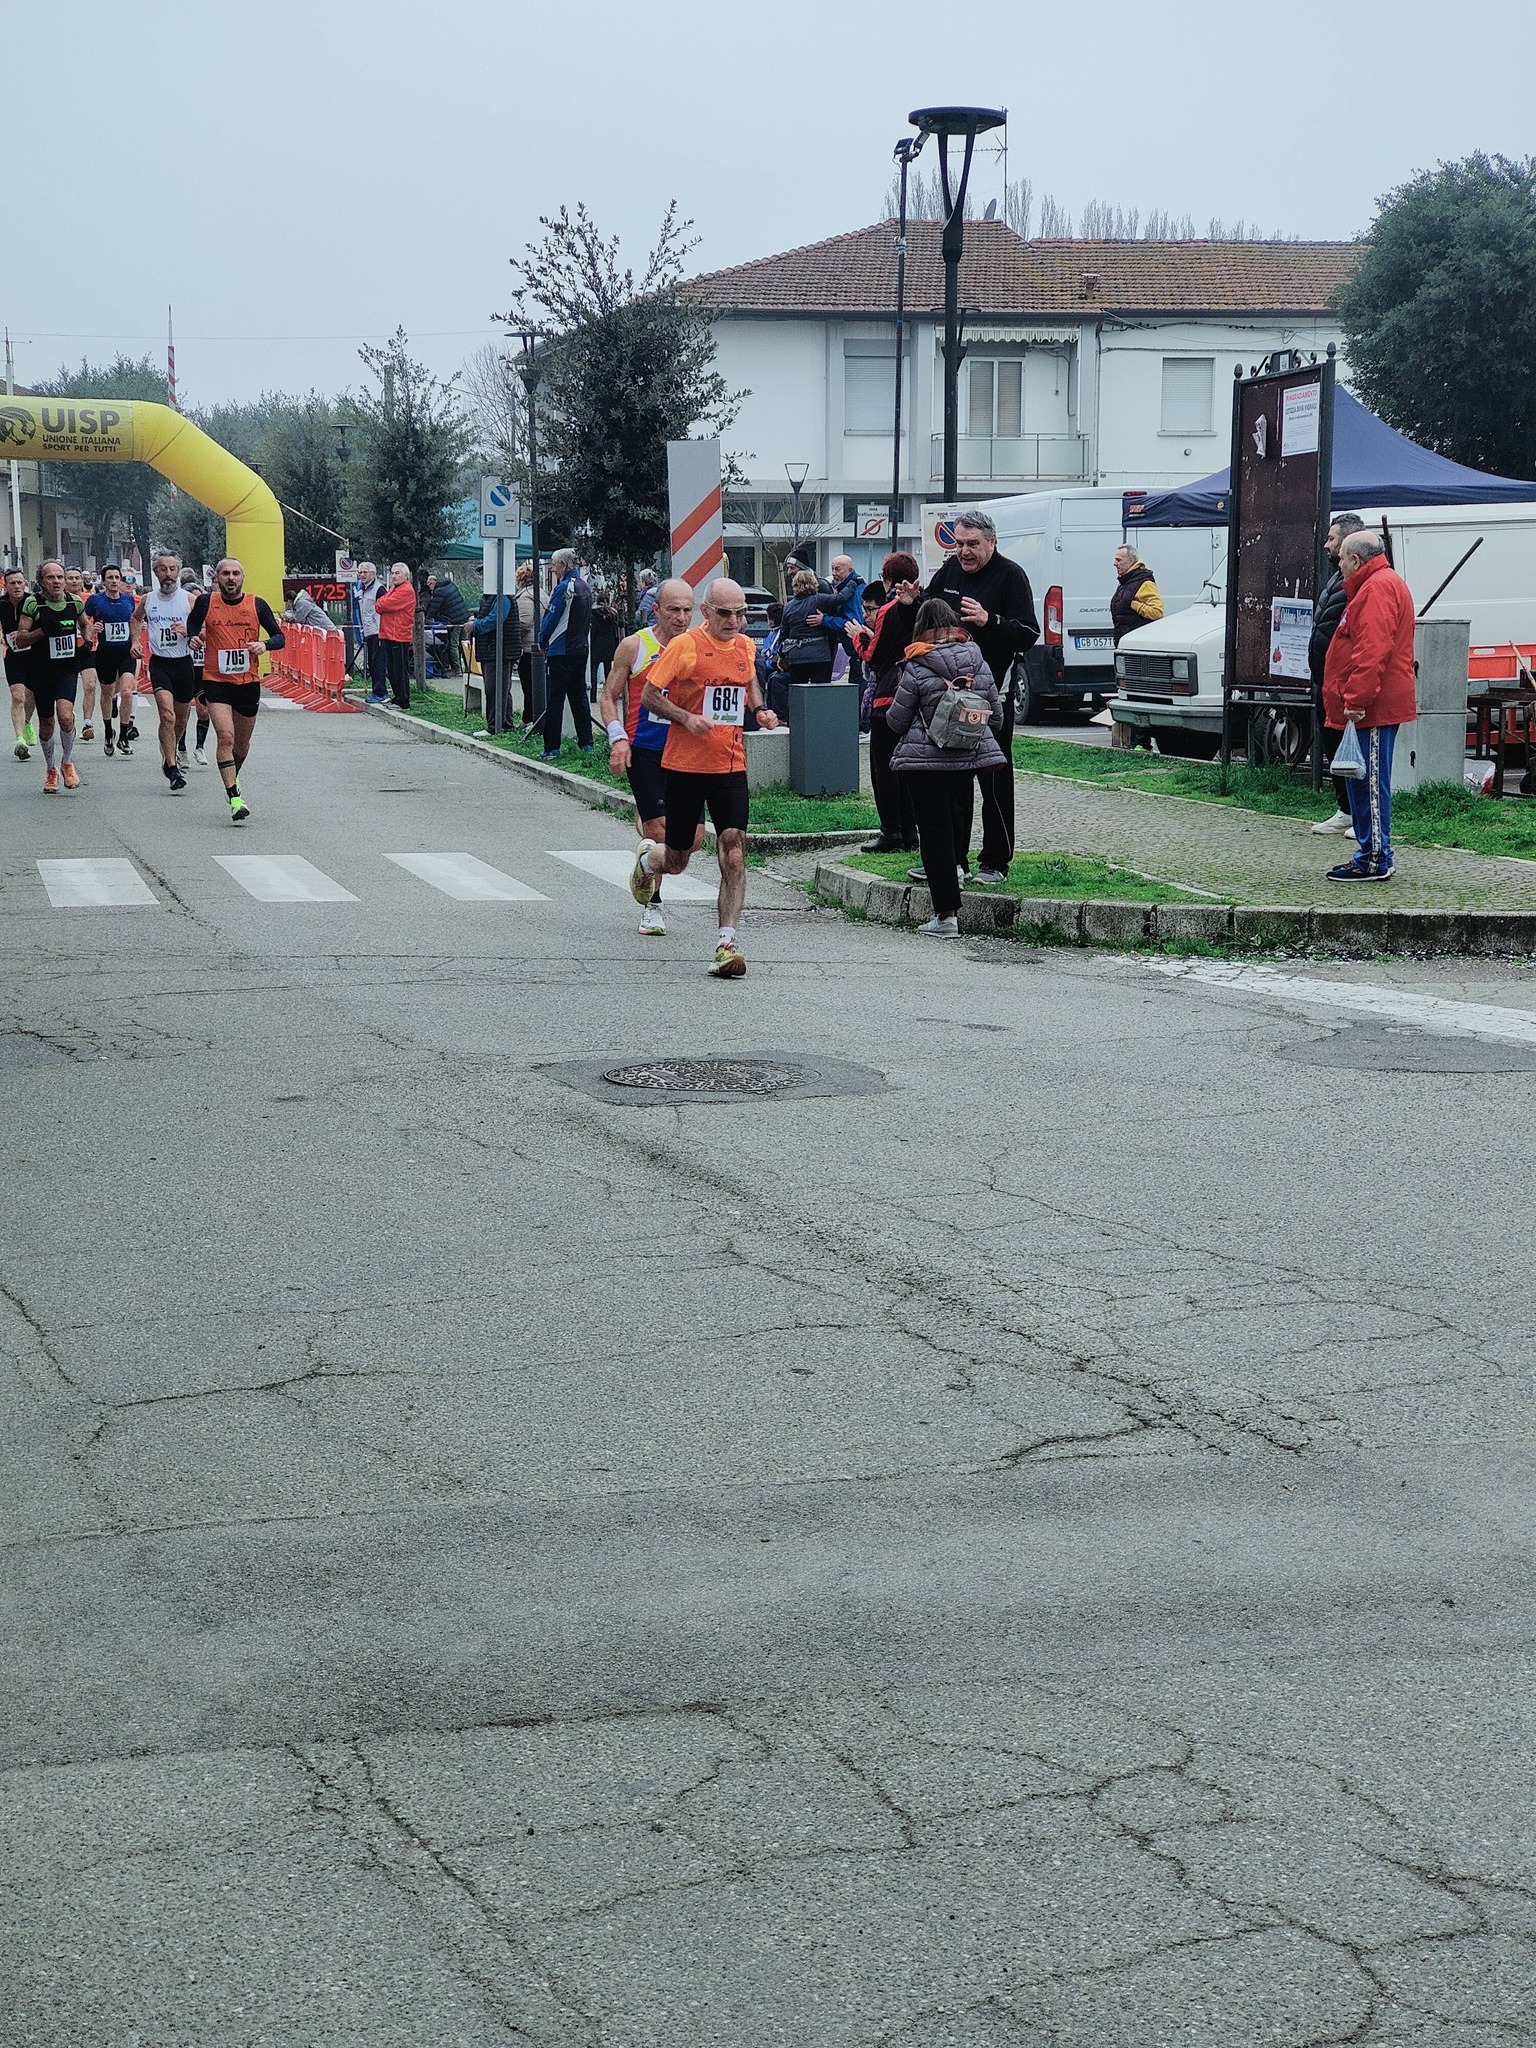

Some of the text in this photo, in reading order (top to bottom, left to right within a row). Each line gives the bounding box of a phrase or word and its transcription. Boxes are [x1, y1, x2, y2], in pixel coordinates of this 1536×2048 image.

[42, 408, 119, 434] UISP
[42, 443, 70, 451] SPORT
[43, 435, 121, 445] UNIONE ITALIANA
[486, 515, 494, 525] P
[306, 584, 346, 600] 17:25
[111, 623, 126, 635] 734
[55, 636, 73, 651] 800
[225, 650, 244, 665] 705
[713, 687, 738, 711] 684
